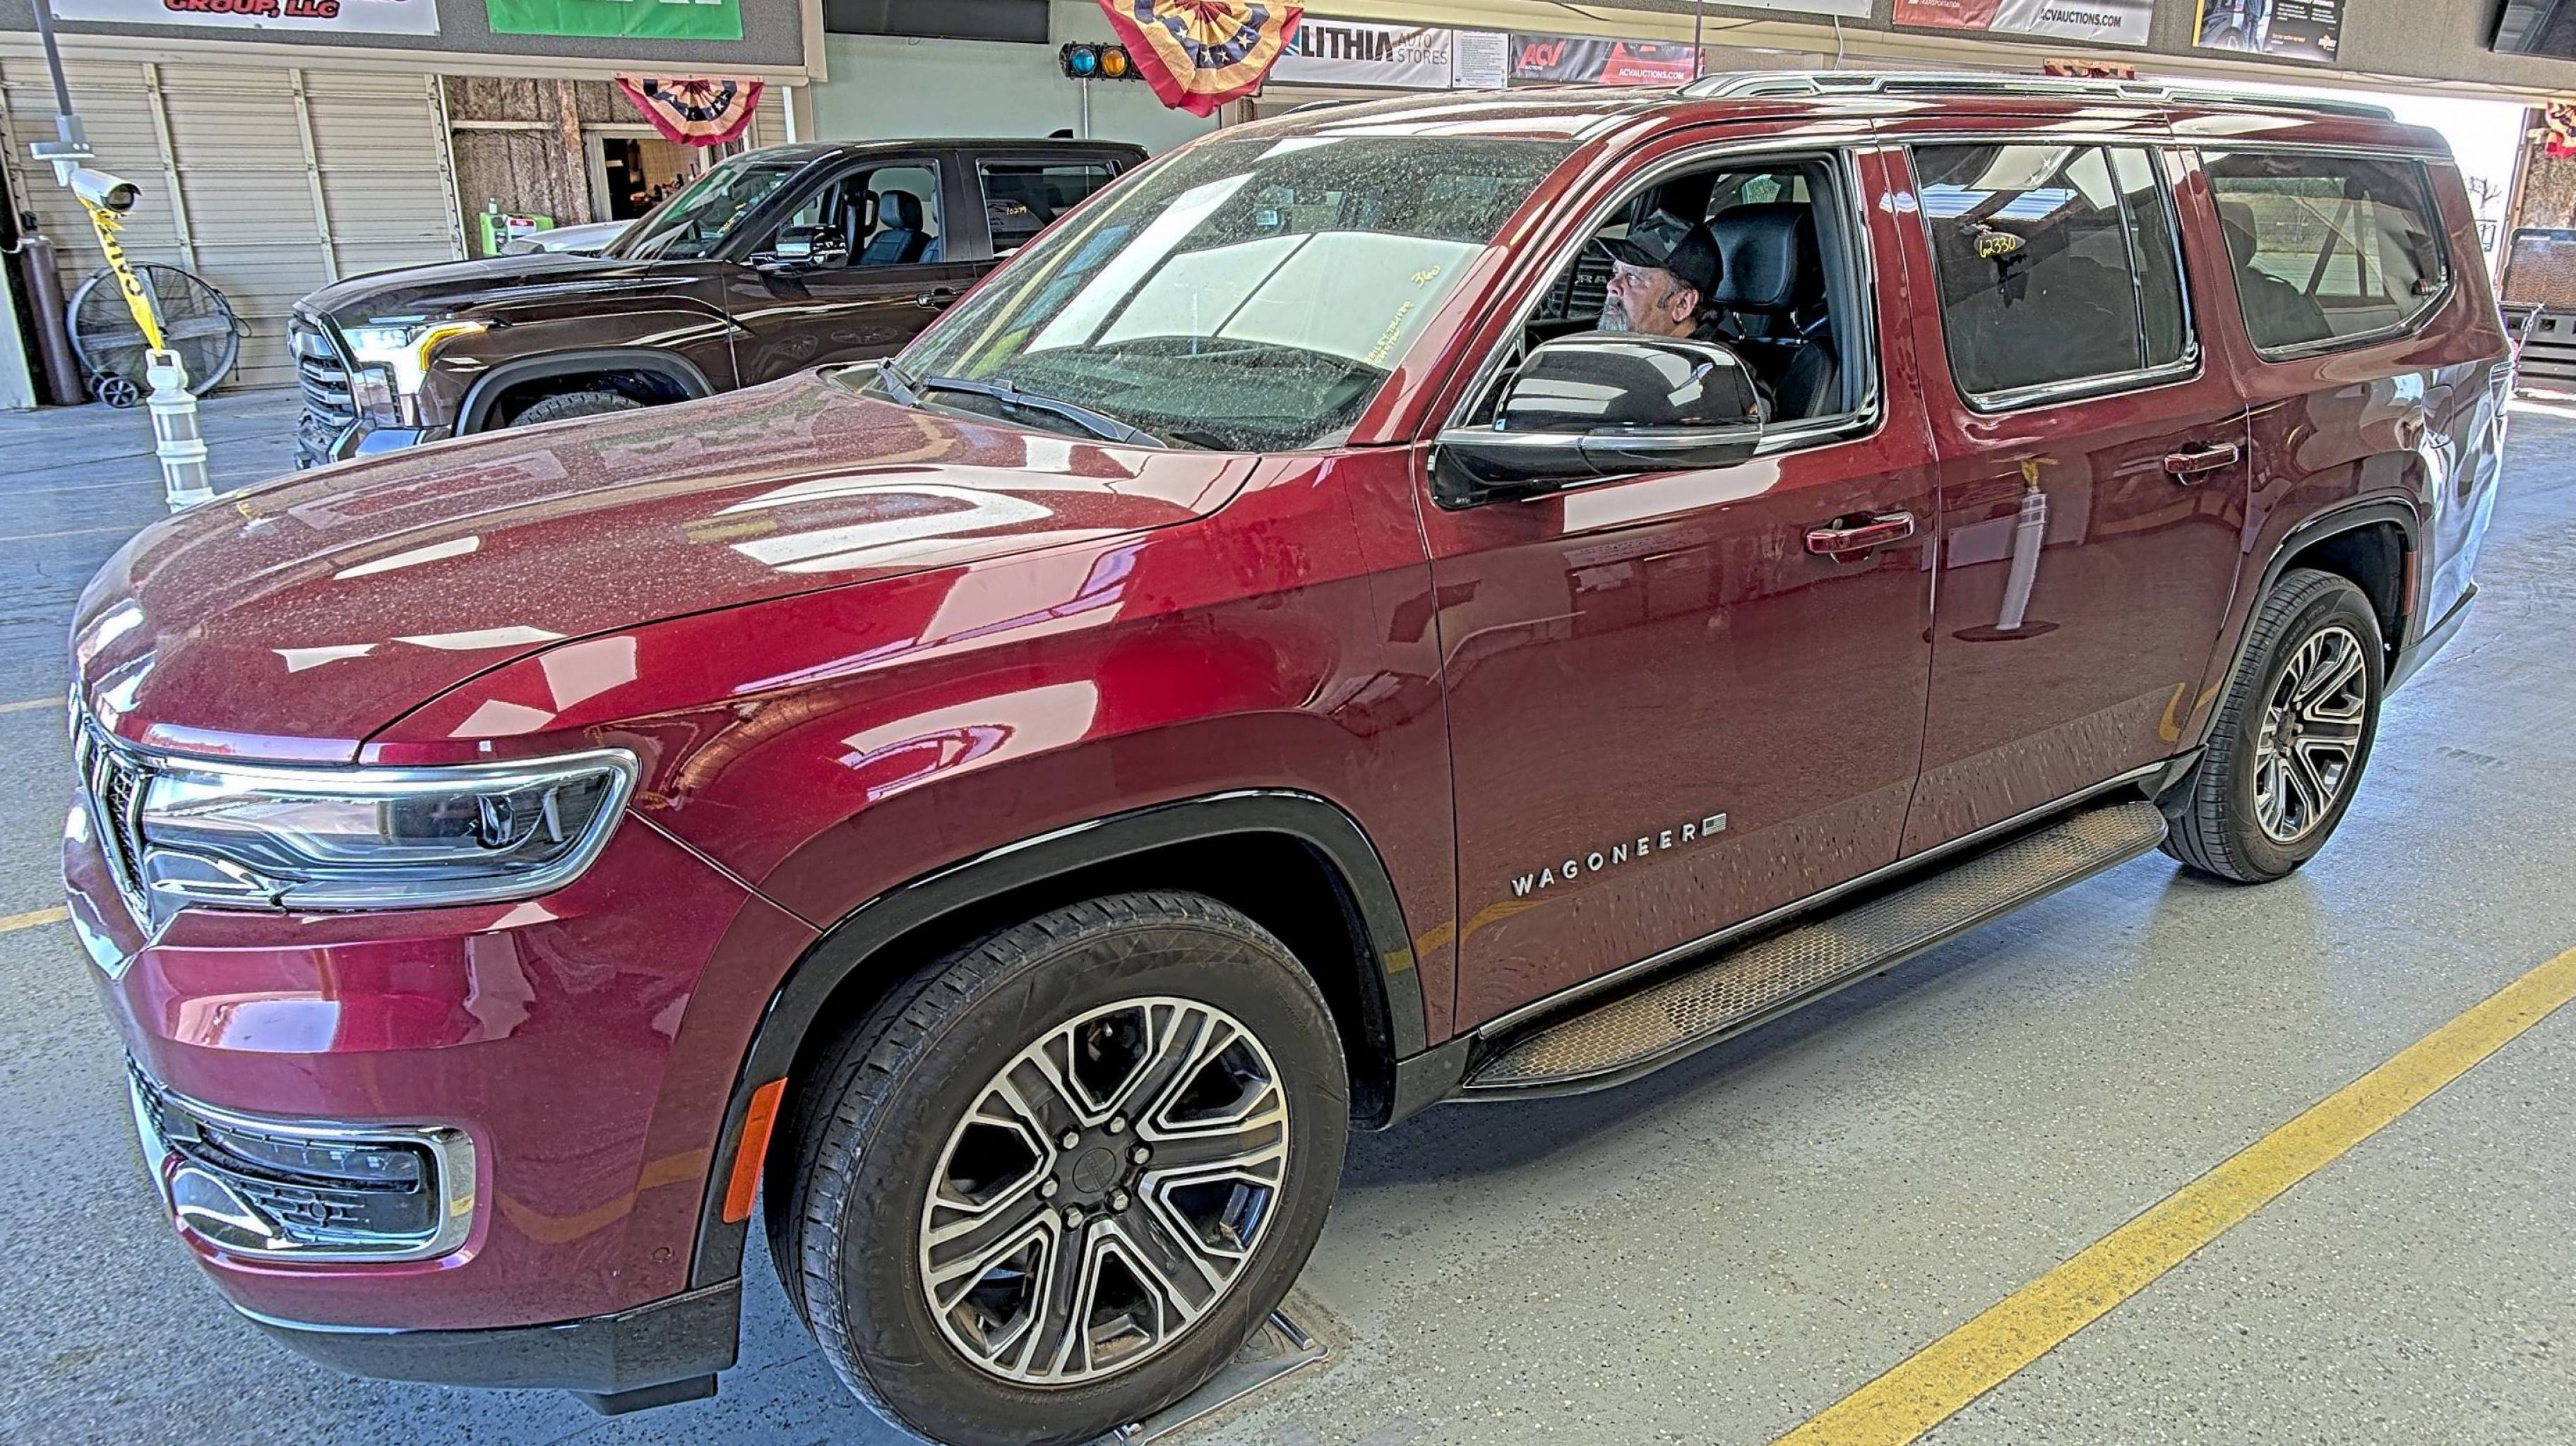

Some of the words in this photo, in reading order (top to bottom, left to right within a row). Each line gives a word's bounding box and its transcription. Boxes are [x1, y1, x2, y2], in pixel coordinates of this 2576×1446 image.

[165, 0, 280, 18] GROUP,
[284, 0, 340, 18] LLC
[1301, 25, 1394, 62] LITHIA
[1397, 32, 1432, 48] AUTO
[1397, 49, 1448, 66] STORES
[1518, 41, 1566, 68] ACV
[1618, 67, 1684, 80] ACVAUCTIONS.COM
[1979, 236, 2016, 258] 62330
[1576, 274, 1608, 284] RA
[1510, 823, 1696, 897] WAGONEER
